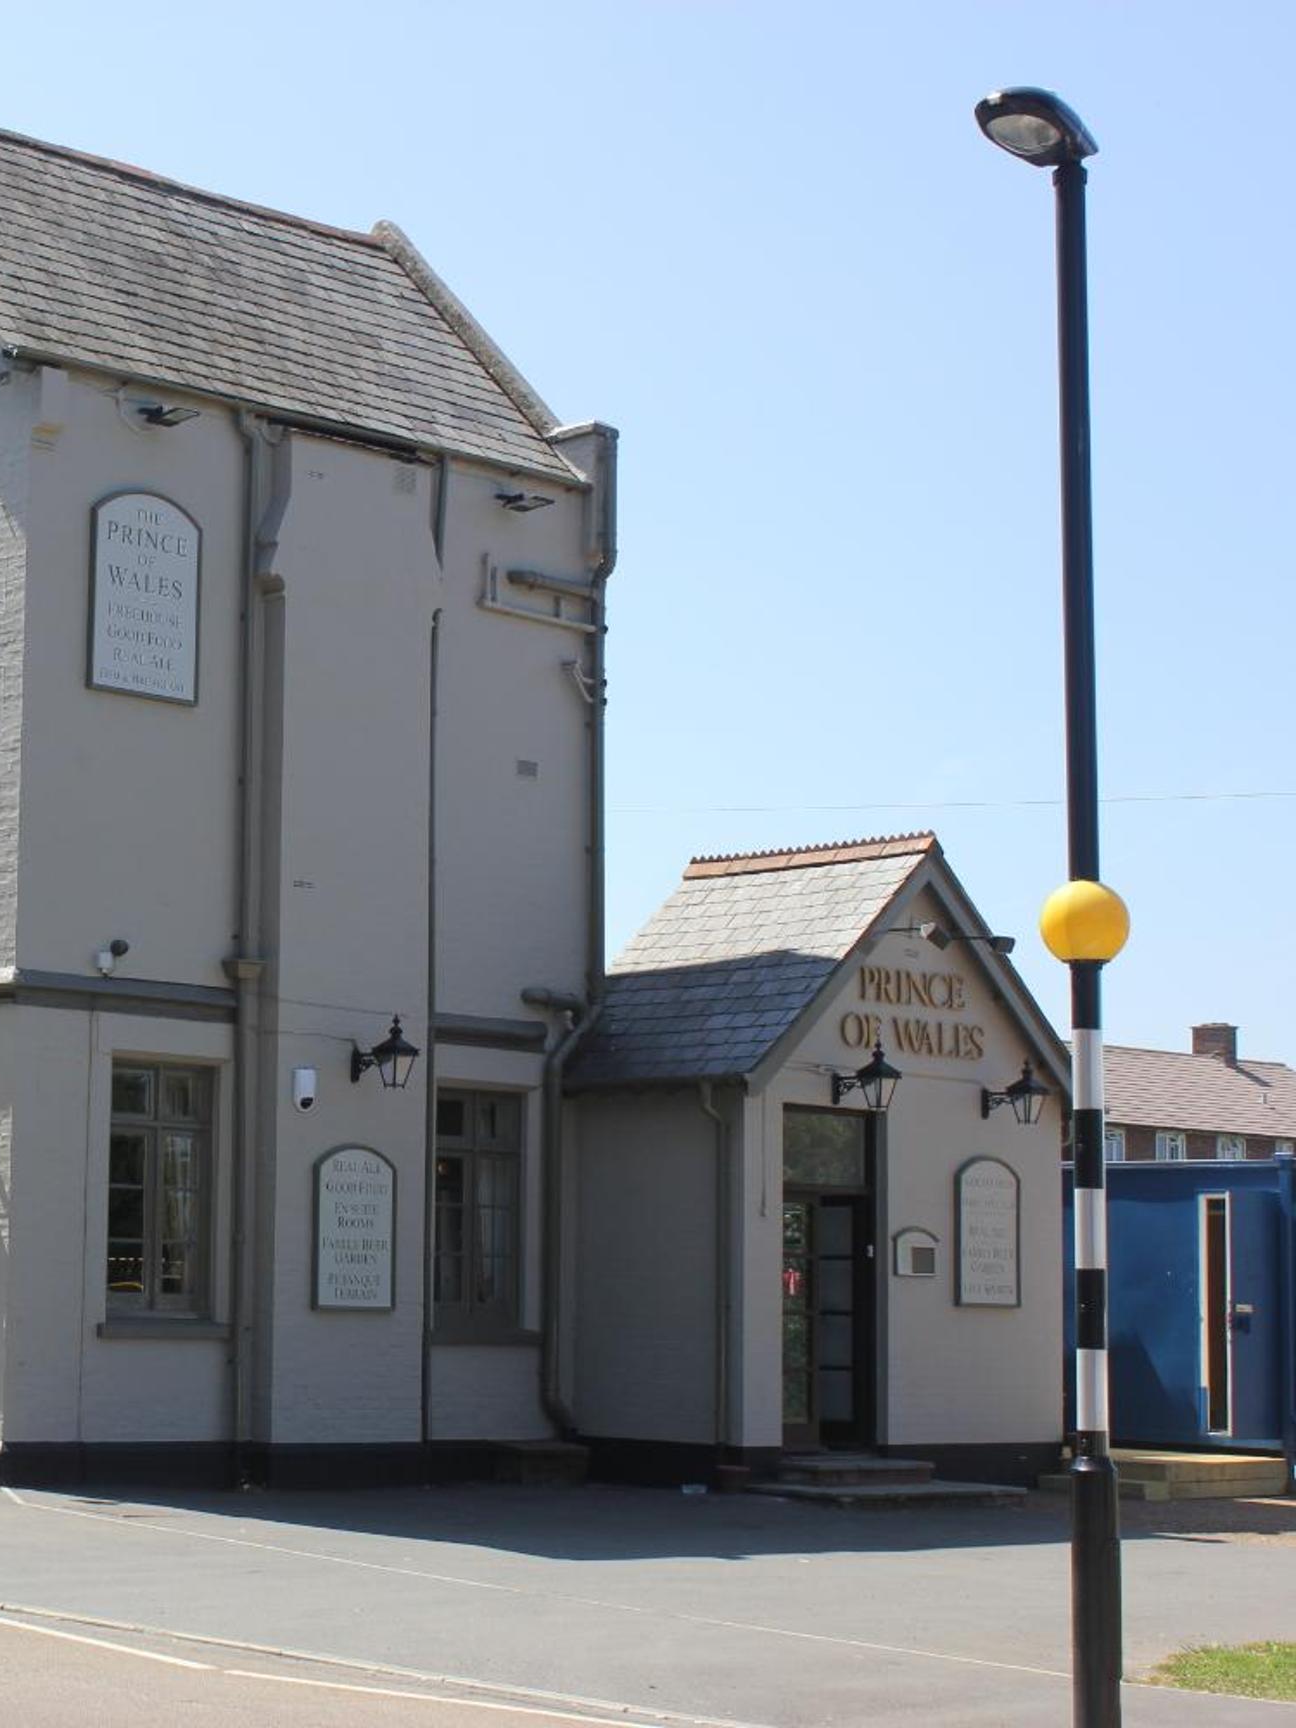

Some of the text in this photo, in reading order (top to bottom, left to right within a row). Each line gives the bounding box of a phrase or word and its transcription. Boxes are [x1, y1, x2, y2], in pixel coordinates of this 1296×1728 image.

[107, 520, 188, 558] PRINCE
[107, 564, 183, 600] WALES
[113, 647, 146, 667] REAL
[859, 965, 966, 1011] PRINCE
[840, 1012, 985, 1061] OF WALES
[337, 1216, 374, 1229] ROOMS
